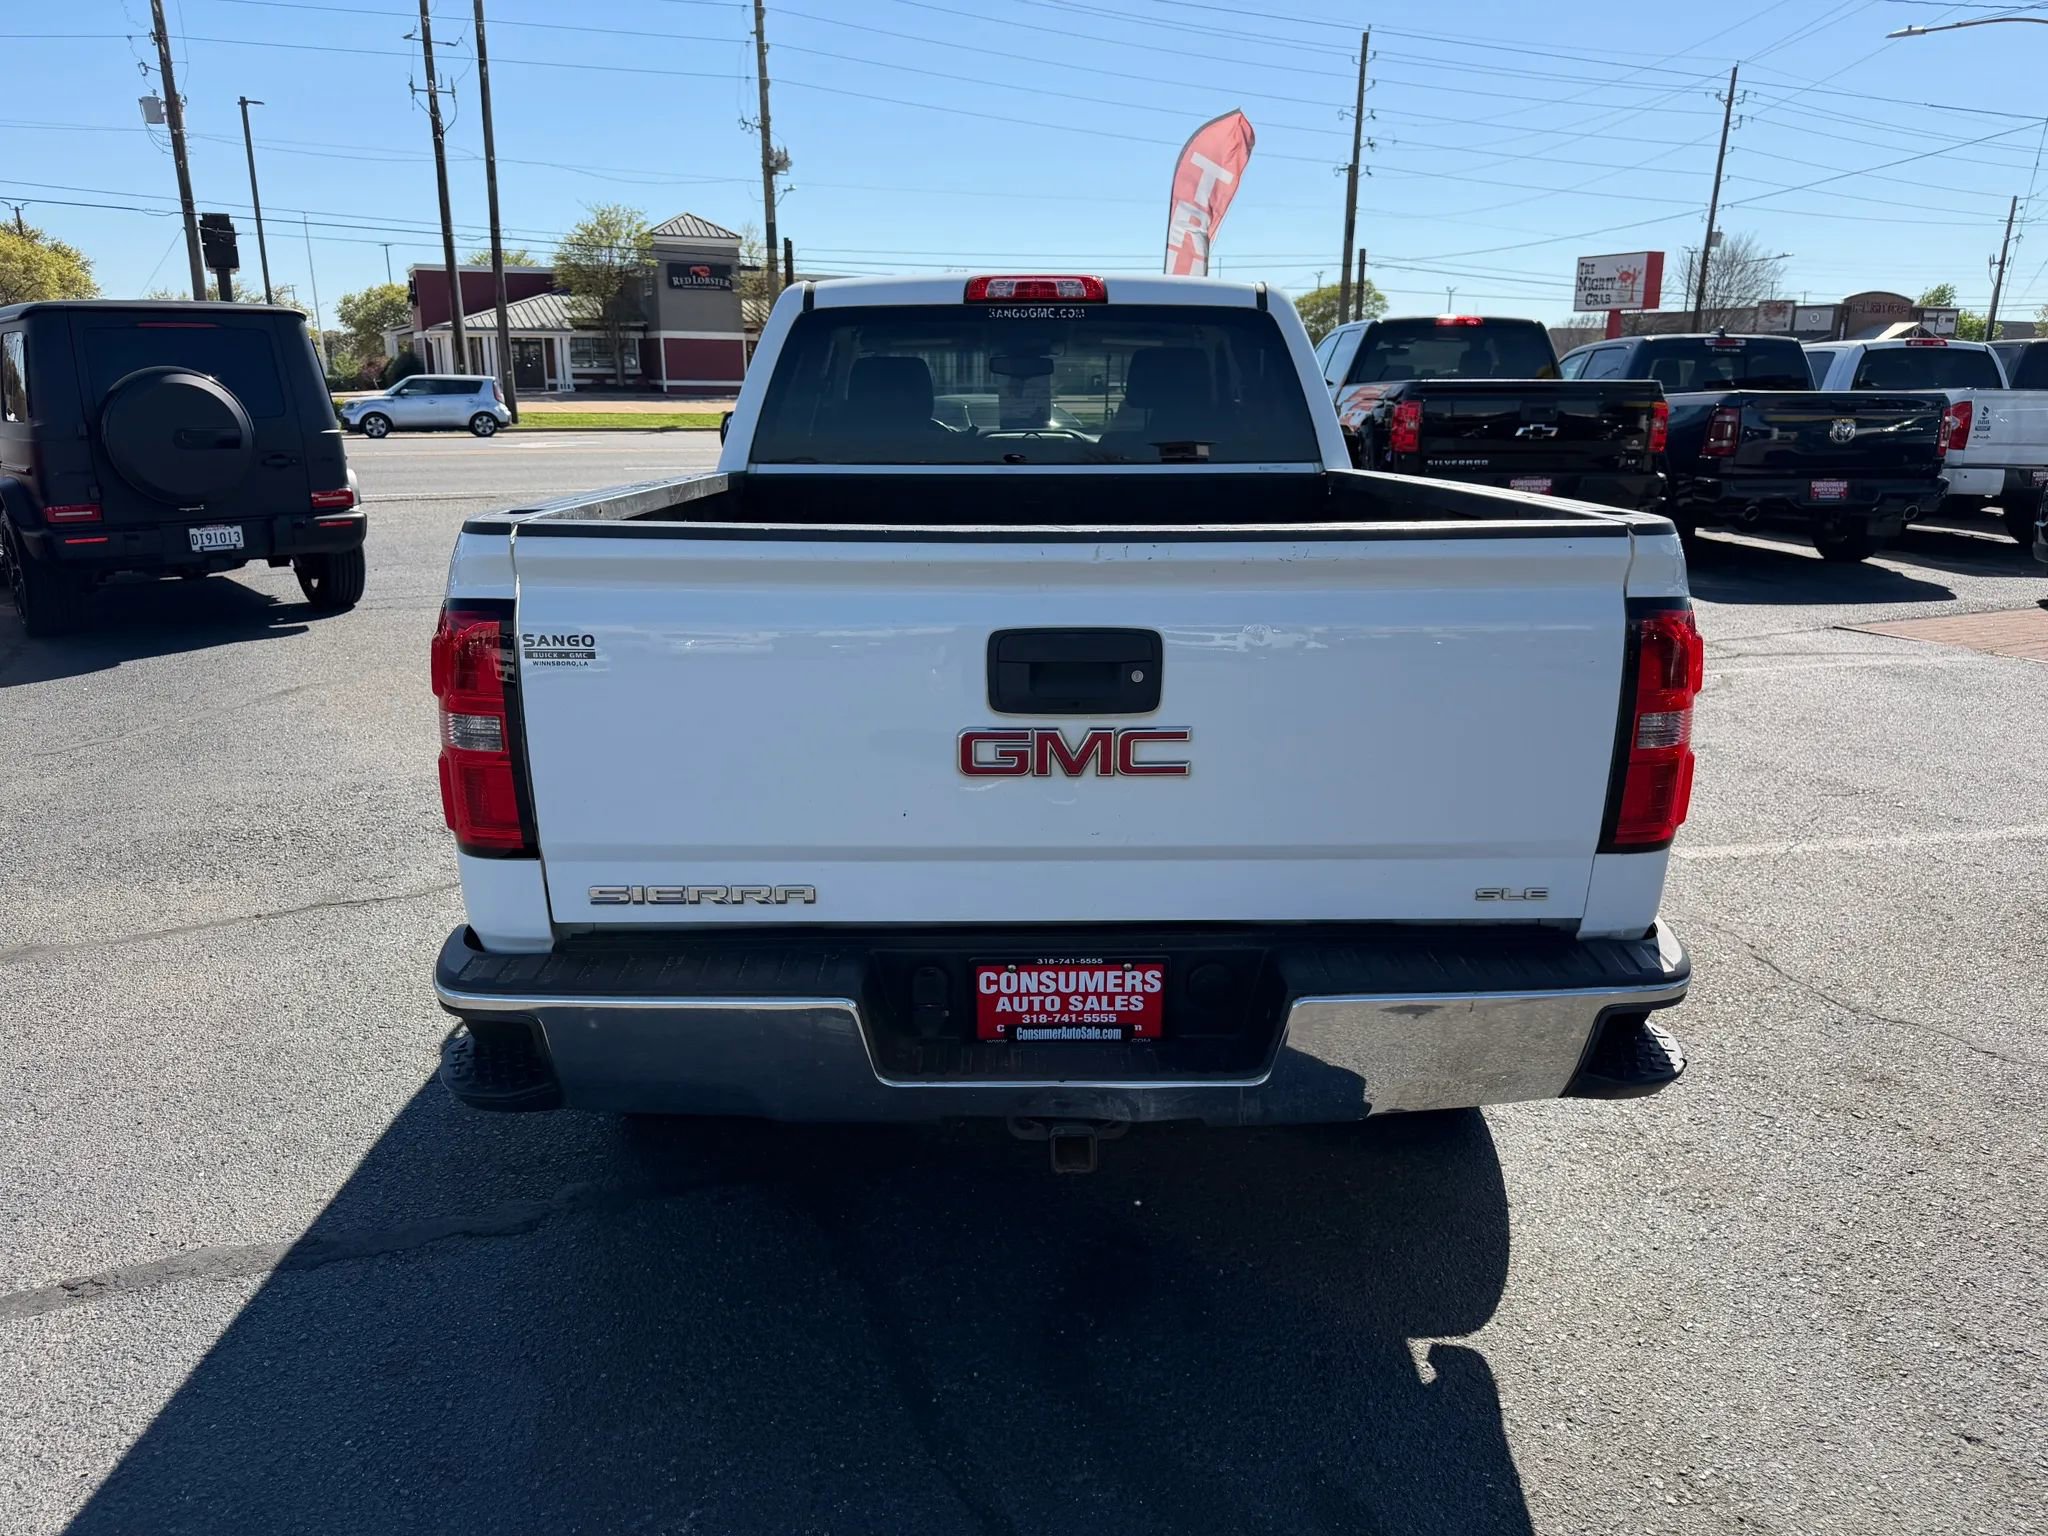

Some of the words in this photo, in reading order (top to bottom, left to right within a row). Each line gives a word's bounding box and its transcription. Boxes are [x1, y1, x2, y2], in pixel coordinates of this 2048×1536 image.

[1580, 262, 1595, 275] THE
[672, 276, 691, 286] RED
[692, 275, 731, 287] LOBSTER
[1578, 276, 1616, 291] MIGHTY
[1585, 293, 1611, 305] CRAB
[988, 307, 1085, 318] SANGOGMC.COM
[191, 531, 241, 546] DI91013
[522, 633, 595, 648] SANGO
[958, 727, 1193, 777] GMC
[588, 884, 817, 905] SIERRA
[1475, 887, 1549, 901] SLE
[979, 971, 1162, 994] CONSUMERS
[995, 996, 1061, 1013] AUTO
[1068, 995, 1145, 1012] SALES
[1022, 1013, 1117, 1024] 318-741-5555
[1016, 1025, 1122, 1041] ConsumerAutoSale.com
